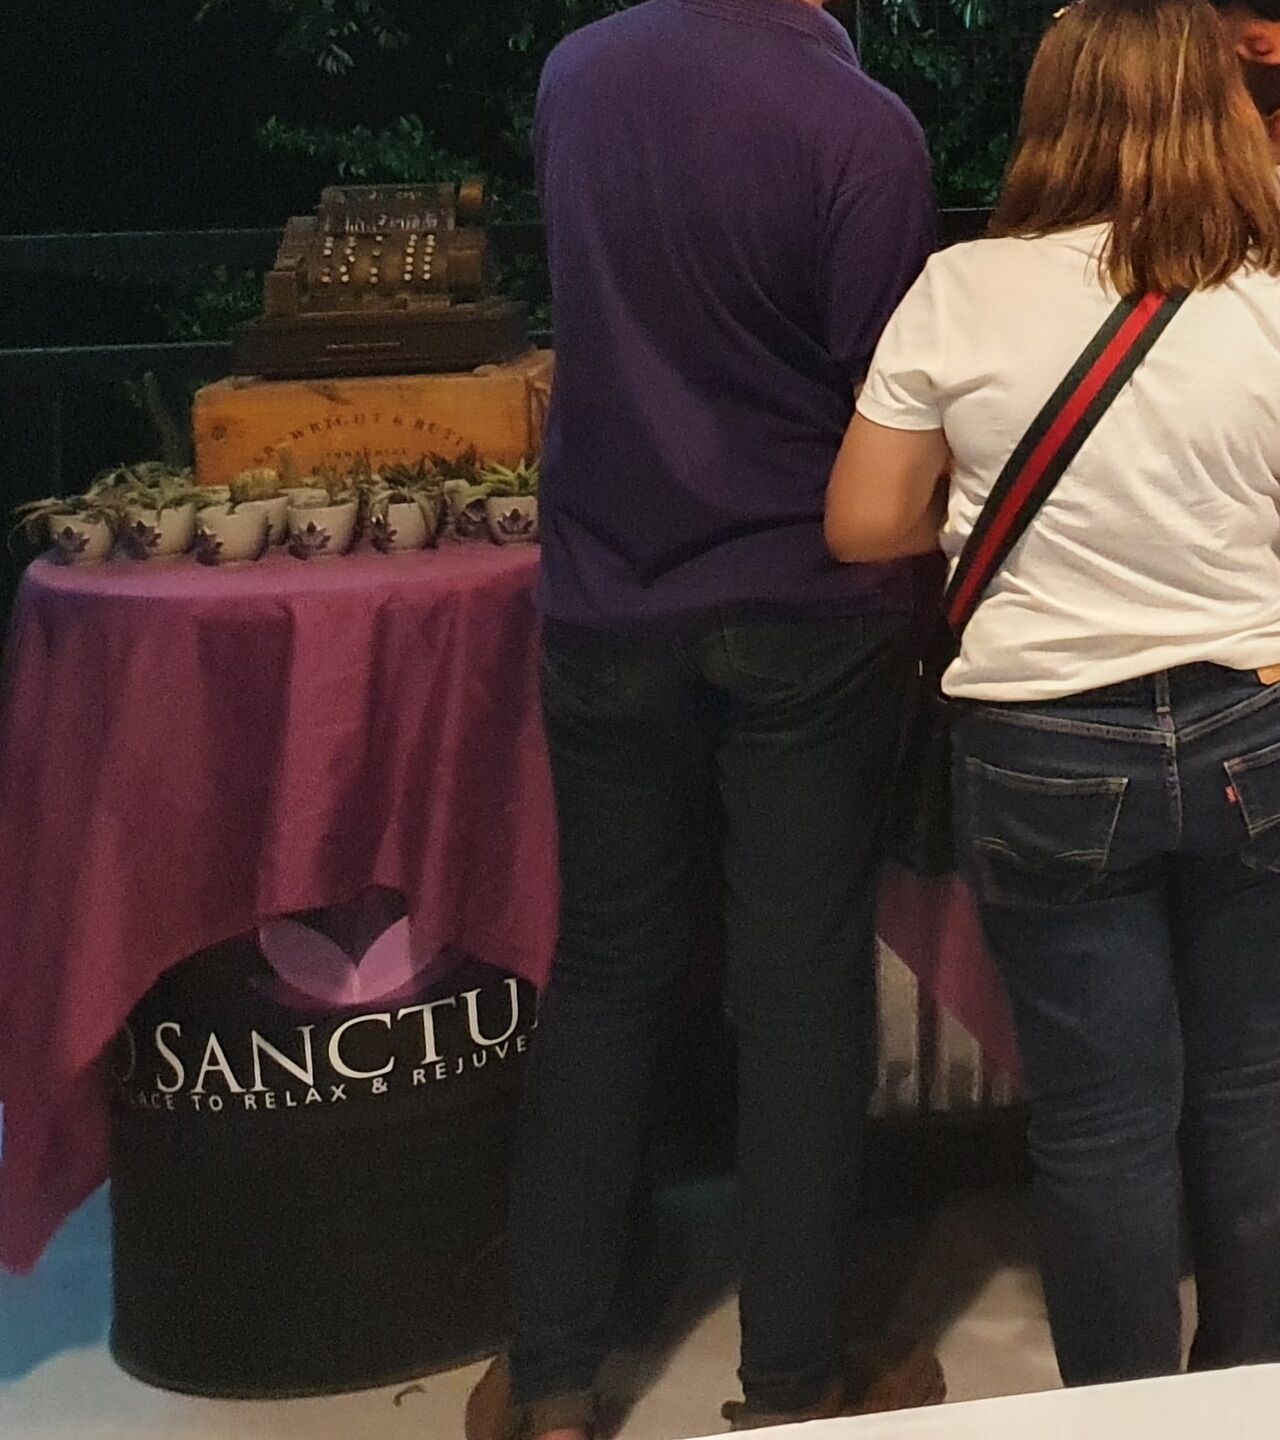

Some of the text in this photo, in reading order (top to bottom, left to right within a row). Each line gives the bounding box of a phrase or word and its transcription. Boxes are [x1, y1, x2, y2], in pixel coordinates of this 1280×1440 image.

[155, 977, 541, 1093] SANCTU
[193, 1094, 224, 1112] TO
[244, 1084, 347, 1111] RELAX
[371, 1076, 388, 1095] &
[413, 1033, 528, 1086] REJUVE
